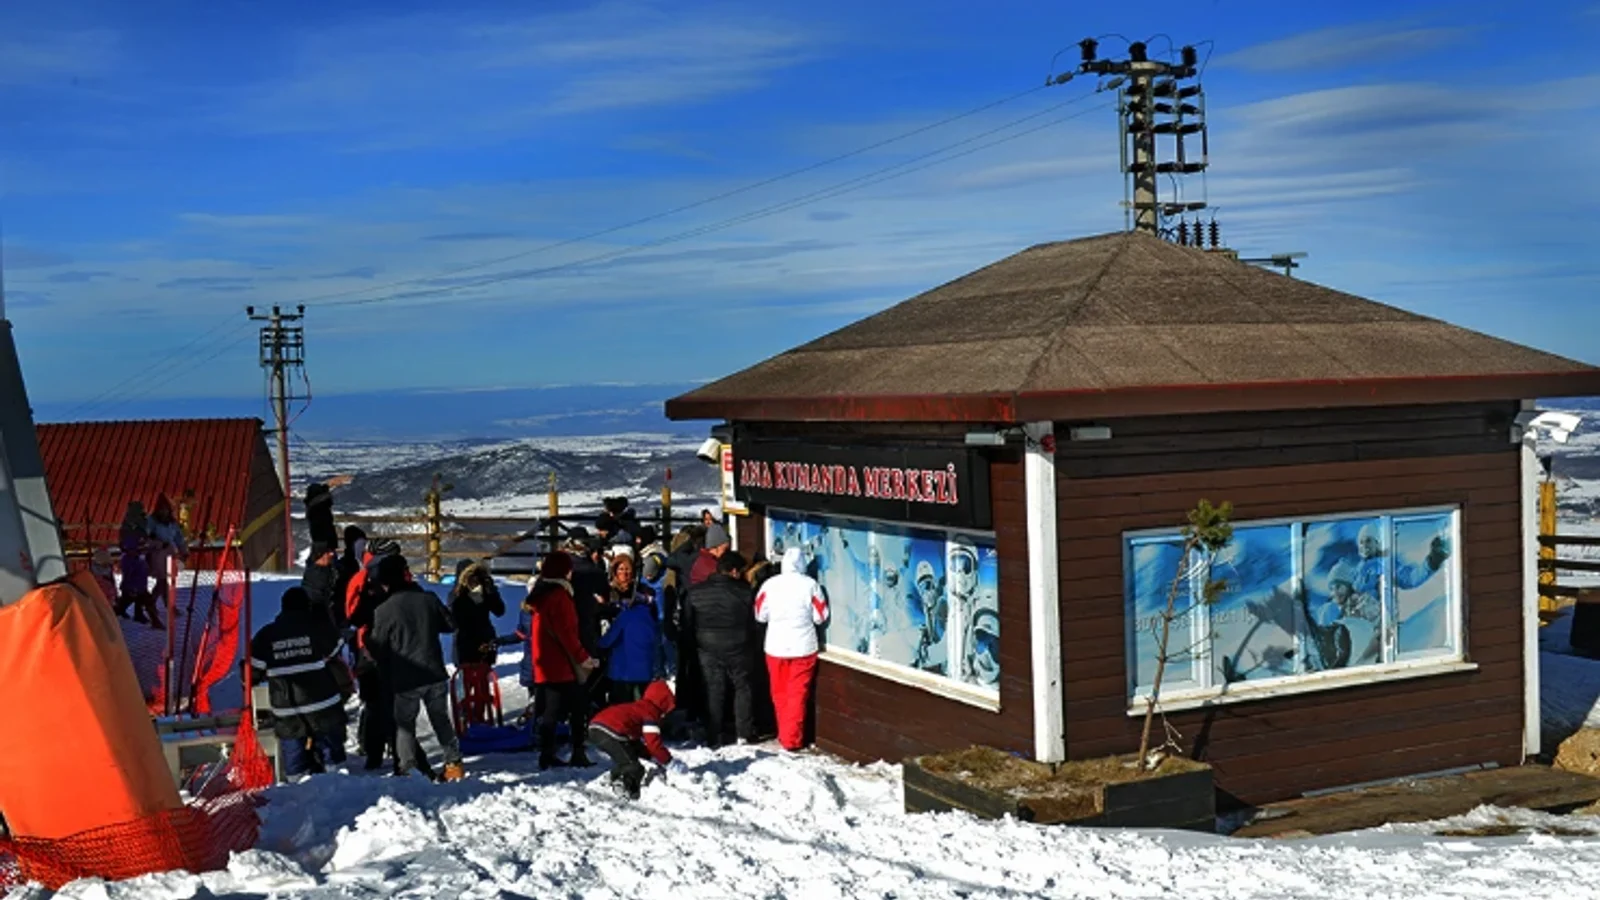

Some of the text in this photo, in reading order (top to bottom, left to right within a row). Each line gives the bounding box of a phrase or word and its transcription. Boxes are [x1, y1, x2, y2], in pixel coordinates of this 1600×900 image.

[740, 459, 773, 488] ANA
[774, 461, 861, 497] KUMANDA
[863, 462, 959, 505] MERKEZİ
